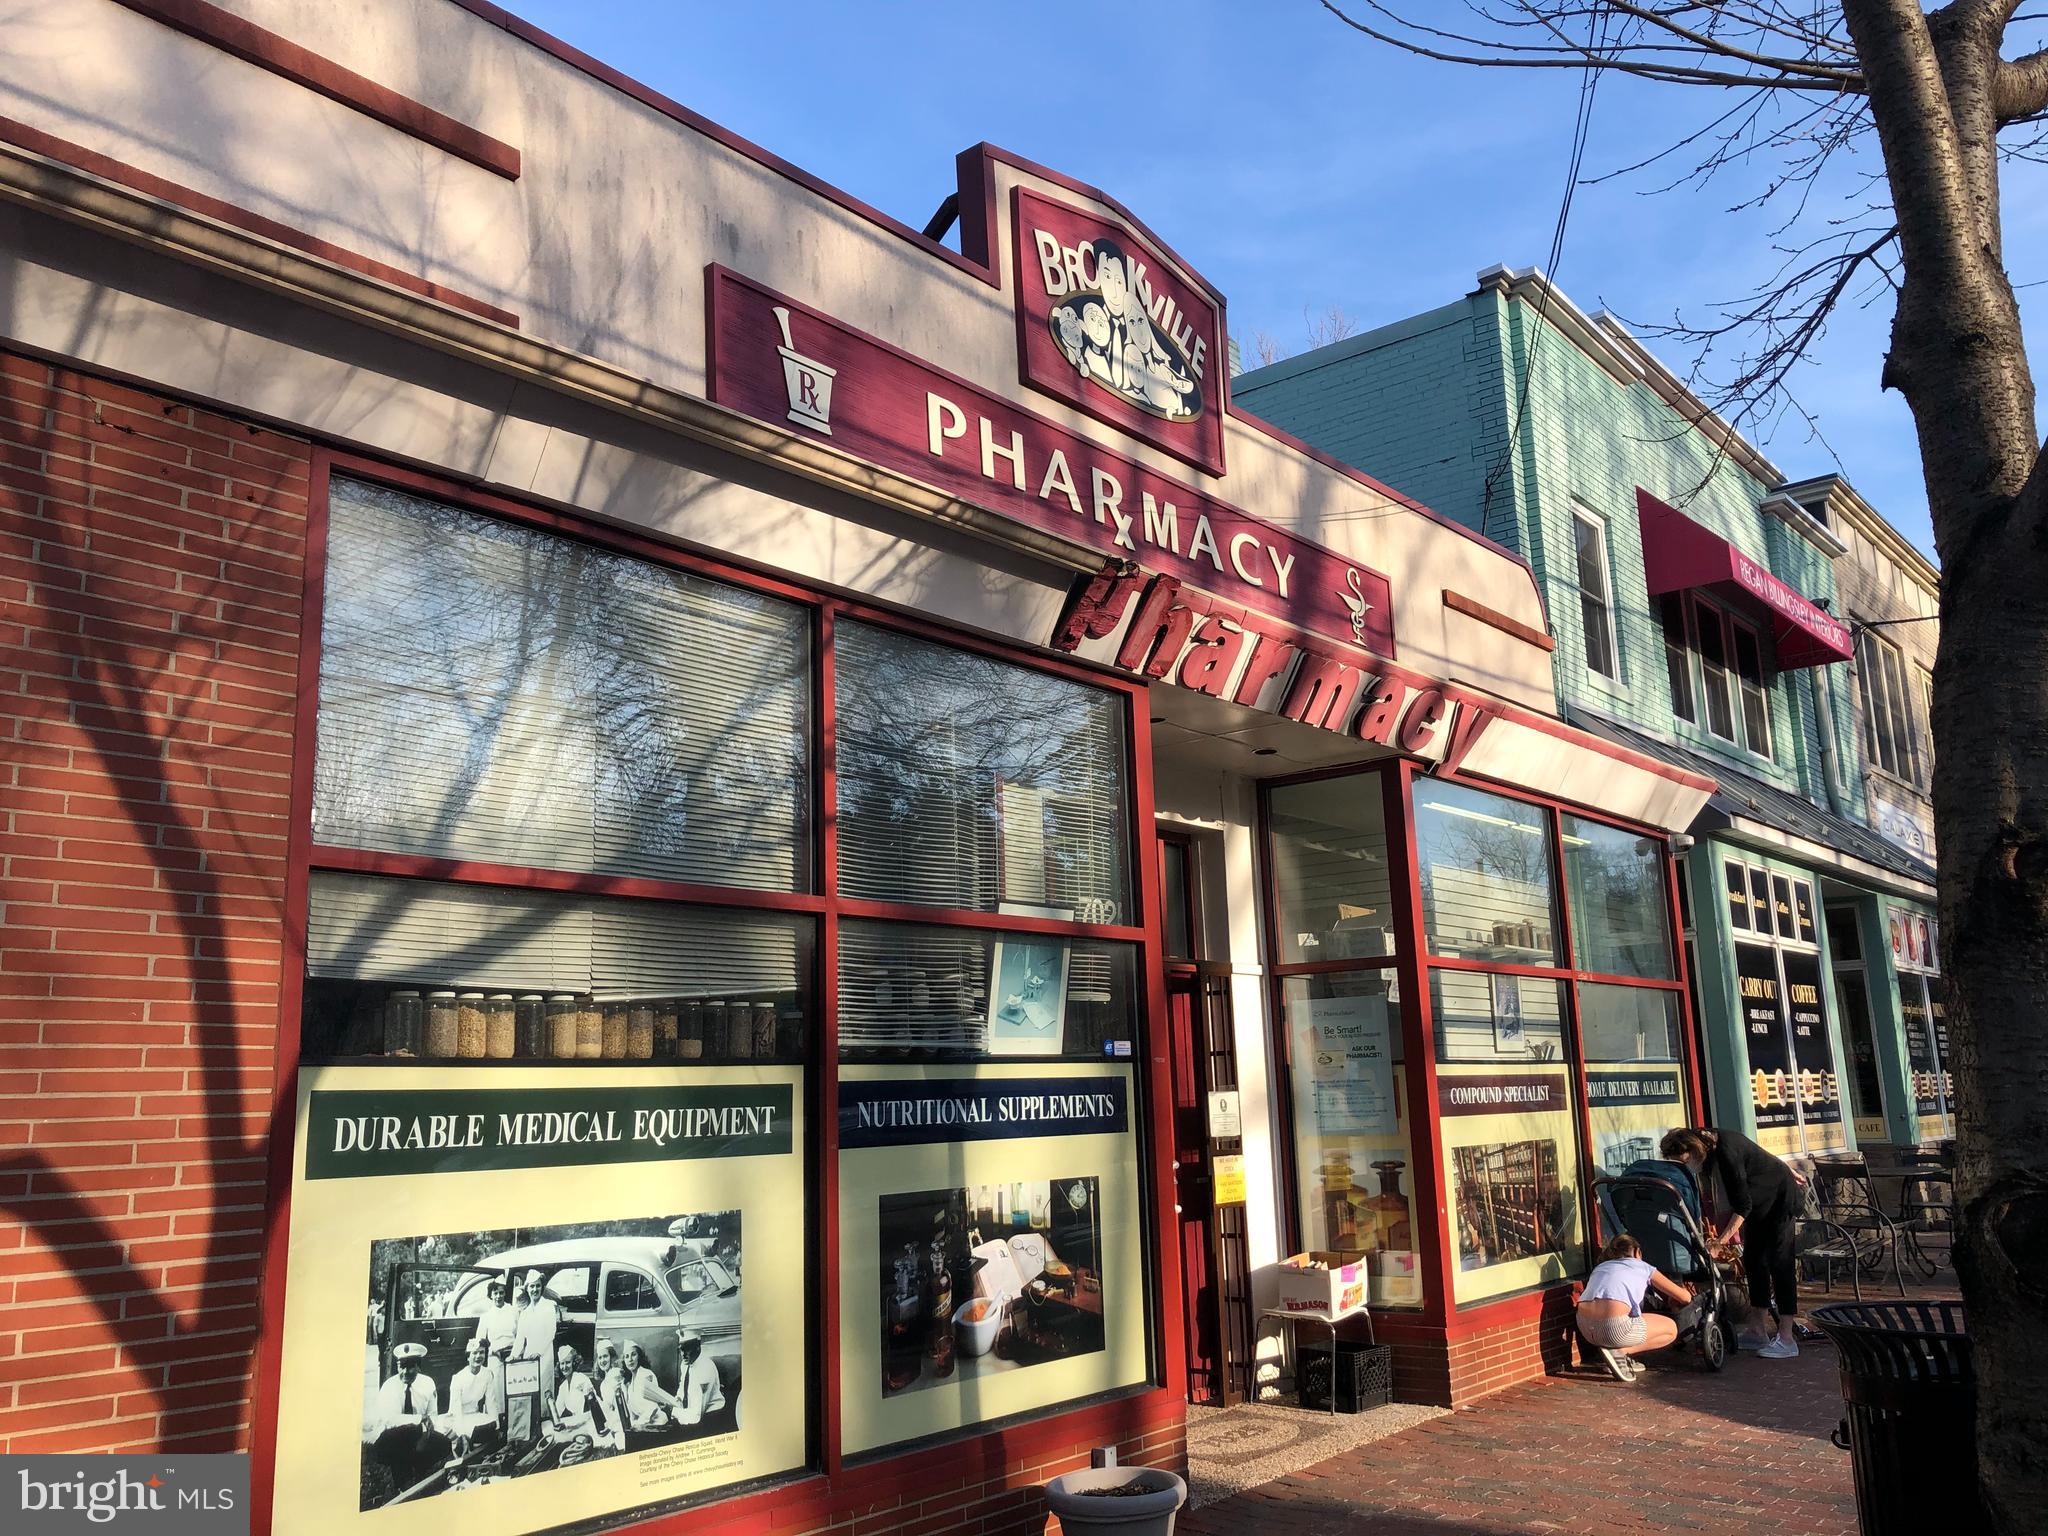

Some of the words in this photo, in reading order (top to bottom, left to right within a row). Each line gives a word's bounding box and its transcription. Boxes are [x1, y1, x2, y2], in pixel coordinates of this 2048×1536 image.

[1740, 558, 1767, 596] REGAN
[1810, 614, 1844, 648] INTERIORS
[1740, 976, 1763, 998] CARRY
[1763, 979, 1778, 999] OUT
[1792, 984, 1818, 1004] COFFEE
[1324, 1026, 1335, 1035] Be
[1337, 1024, 1362, 1034] Smart!
[1451, 1086, 1502, 1104] COMPOUND
[1504, 1084, 1550, 1101] SPECIALIST
[1608, 1081, 1640, 1097] DELIVERY
[1643, 1080, 1676, 1095] AVAILABLE
[857, 1097, 993, 1128] NUTRITIONAL
[999, 1094, 1115, 1121] SUPPLEMENTS
[332, 1115, 485, 1153] DURABLE
[496, 1111, 622, 1147] MEDICAL
[632, 1105, 776, 1147] EQUIPMENT
